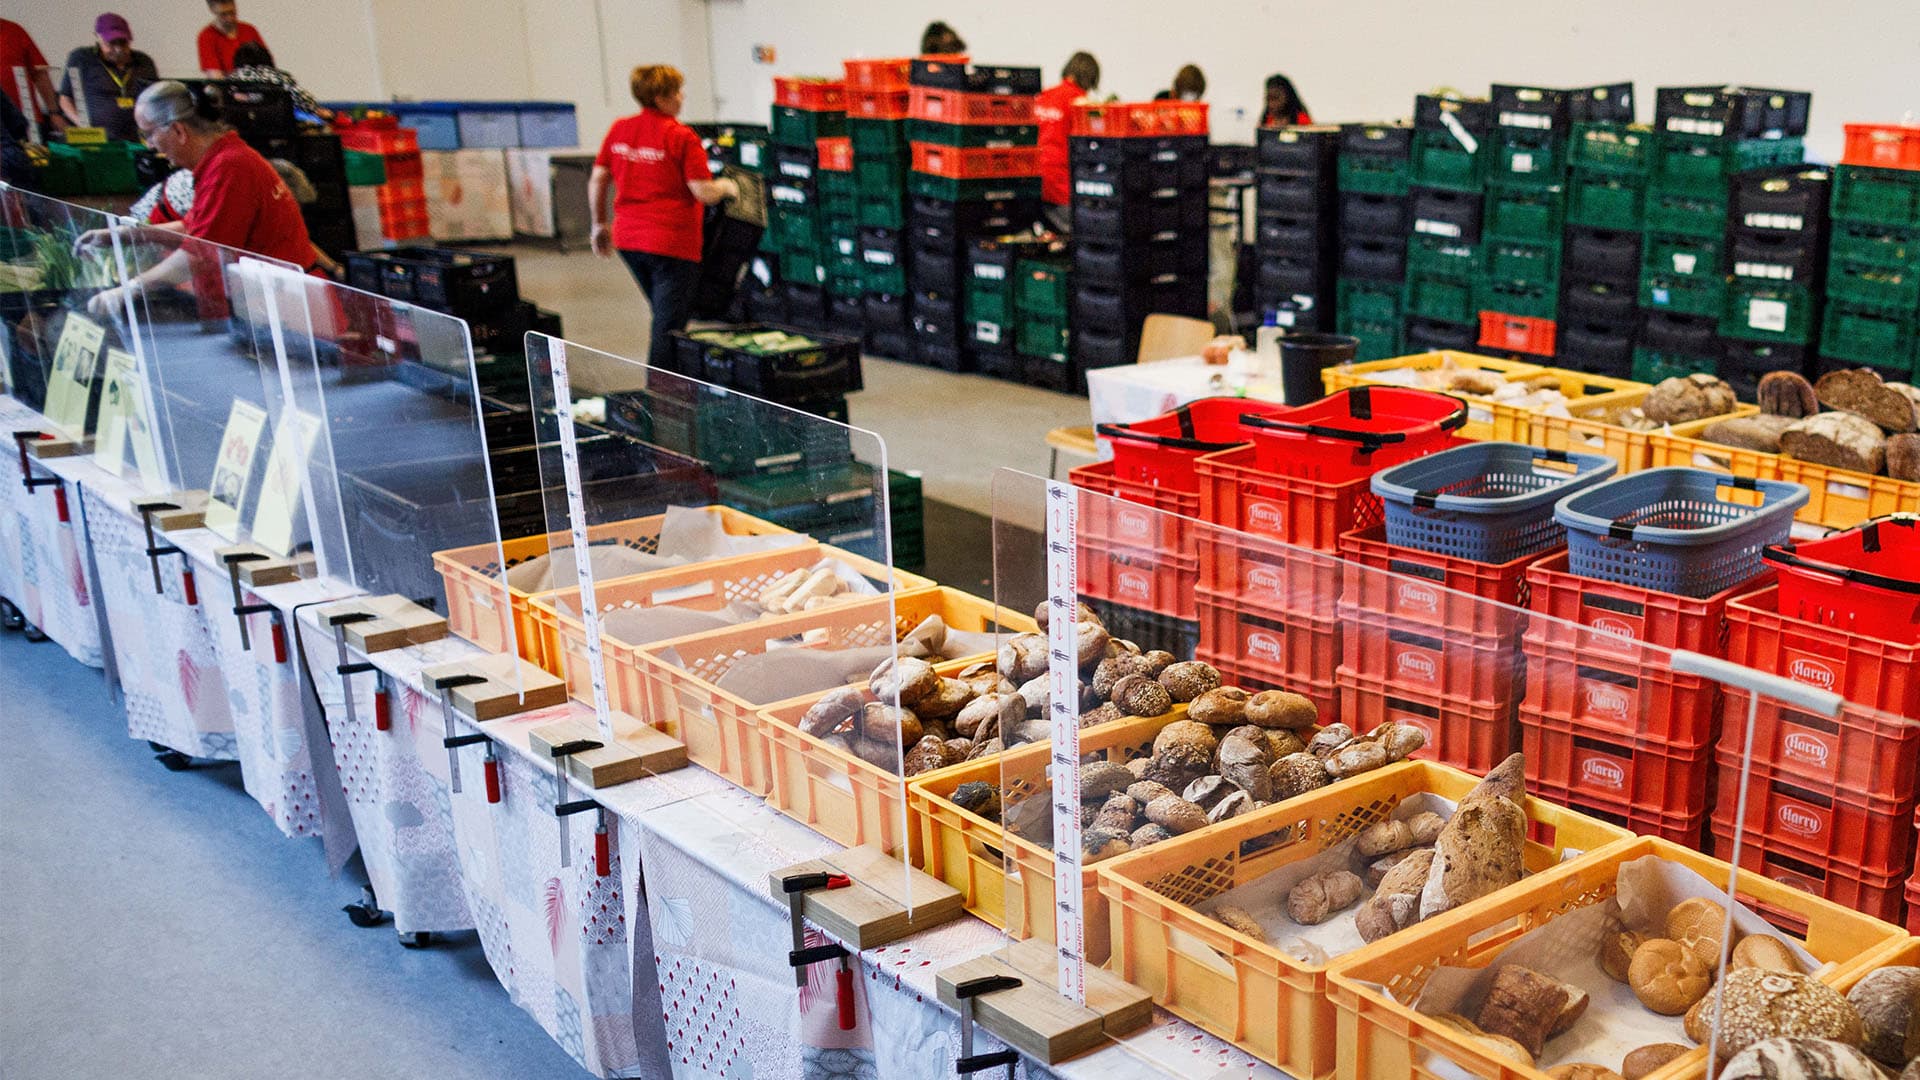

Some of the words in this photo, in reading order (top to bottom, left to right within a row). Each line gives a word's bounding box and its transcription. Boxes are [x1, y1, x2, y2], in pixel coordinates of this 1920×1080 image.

[1249, 635, 1280, 656] Harry
[1794, 661, 1831, 686] Harry
[1789, 735, 1825, 762] Harry
[1586, 761, 1621, 782] Harry
[1783, 806, 1818, 832] Harry
